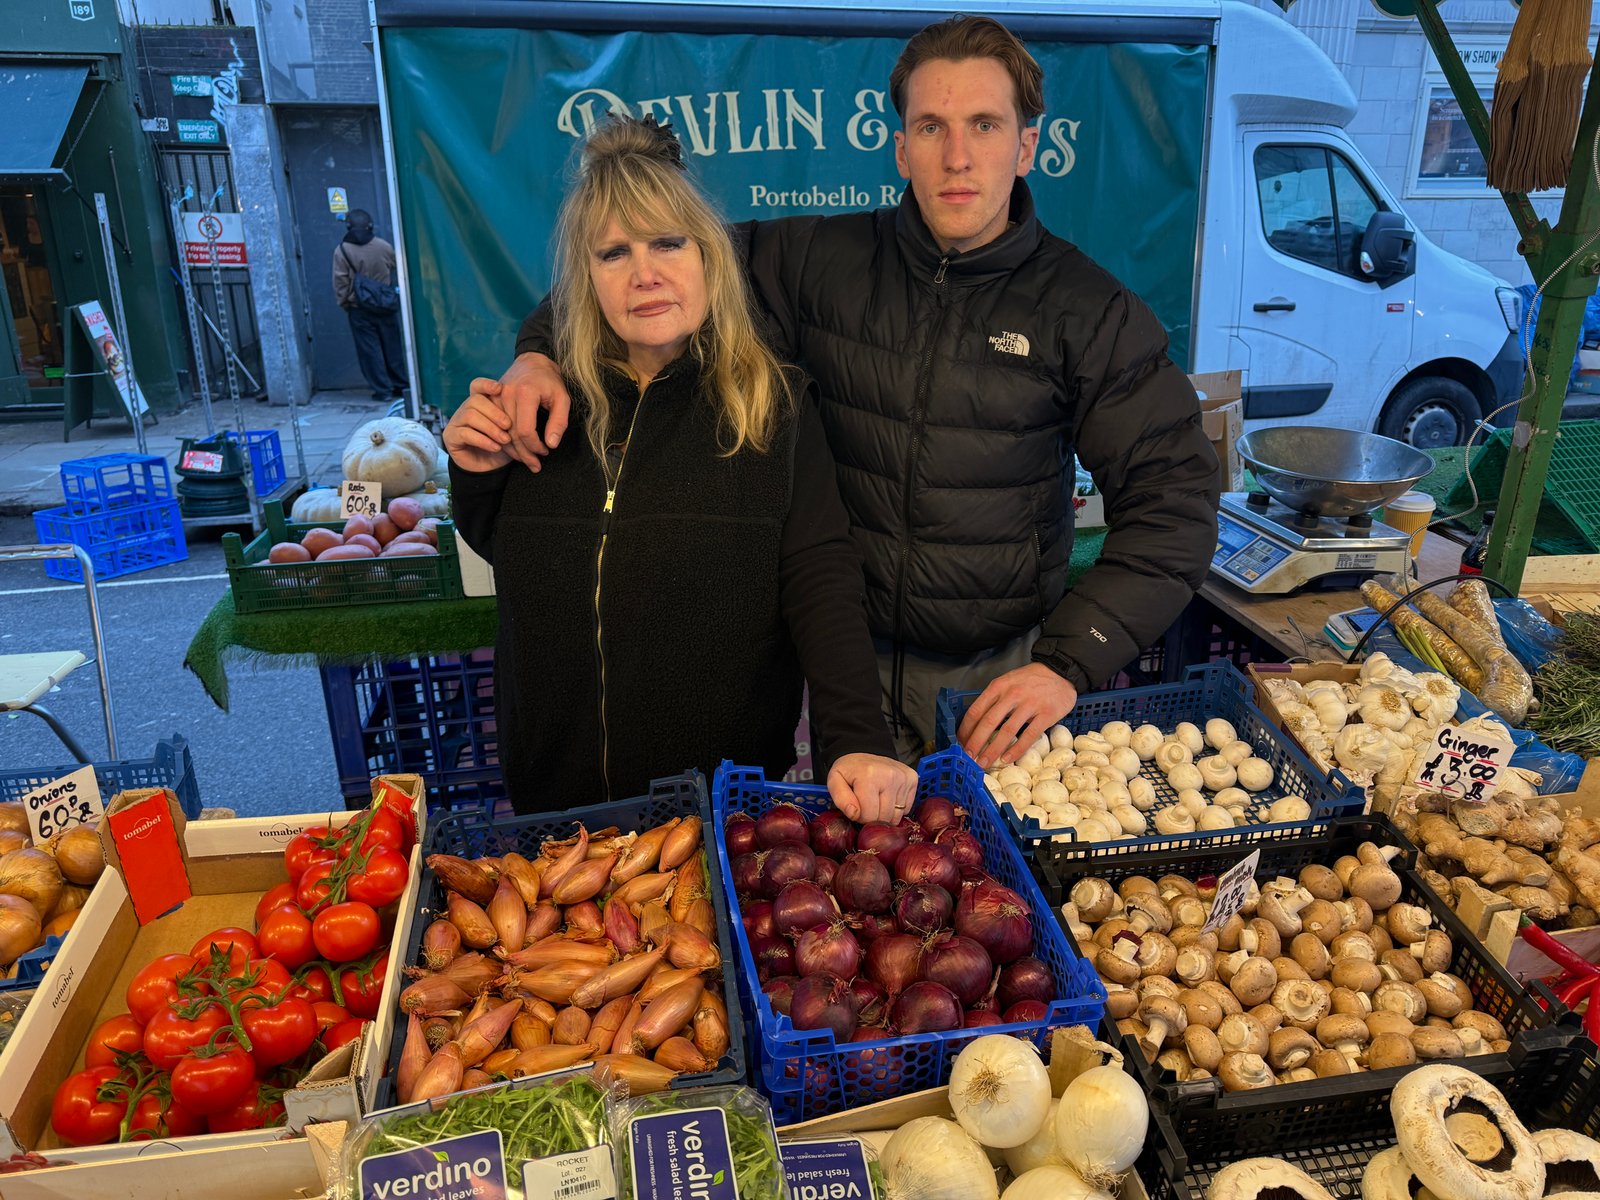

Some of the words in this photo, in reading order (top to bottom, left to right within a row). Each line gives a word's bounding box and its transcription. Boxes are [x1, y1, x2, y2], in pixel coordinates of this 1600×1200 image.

[73, 5, 90, 15] 189
[847, 89, 889, 151] &
[749, 185, 870, 207] Portobello
[988, 335, 1016, 348] NORTH
[1002, 331, 1018, 340] THE
[994, 344, 1015, 354] FACE
[1090, 626, 1107, 643] 700
[1437, 728, 1499, 764] Ginger
[29, 781, 77, 810] Onions
[123, 814, 162, 841] tomabel
[258, 826, 304, 838] tomabel
[52, 965, 75, 1009] tomabel
[667, 1130, 679, 1156] fresh
[556, 1156, 589, 1168] ROCKET
[682, 1120, 714, 1200] verdin
[373, 1157, 492, 1200] verdino
[669, 1158, 683, 1185] salad
[798, 1170, 823, 1181] salad
[825, 1168, 850, 1178] fresh
[792, 1181, 862, 1200] verdi
